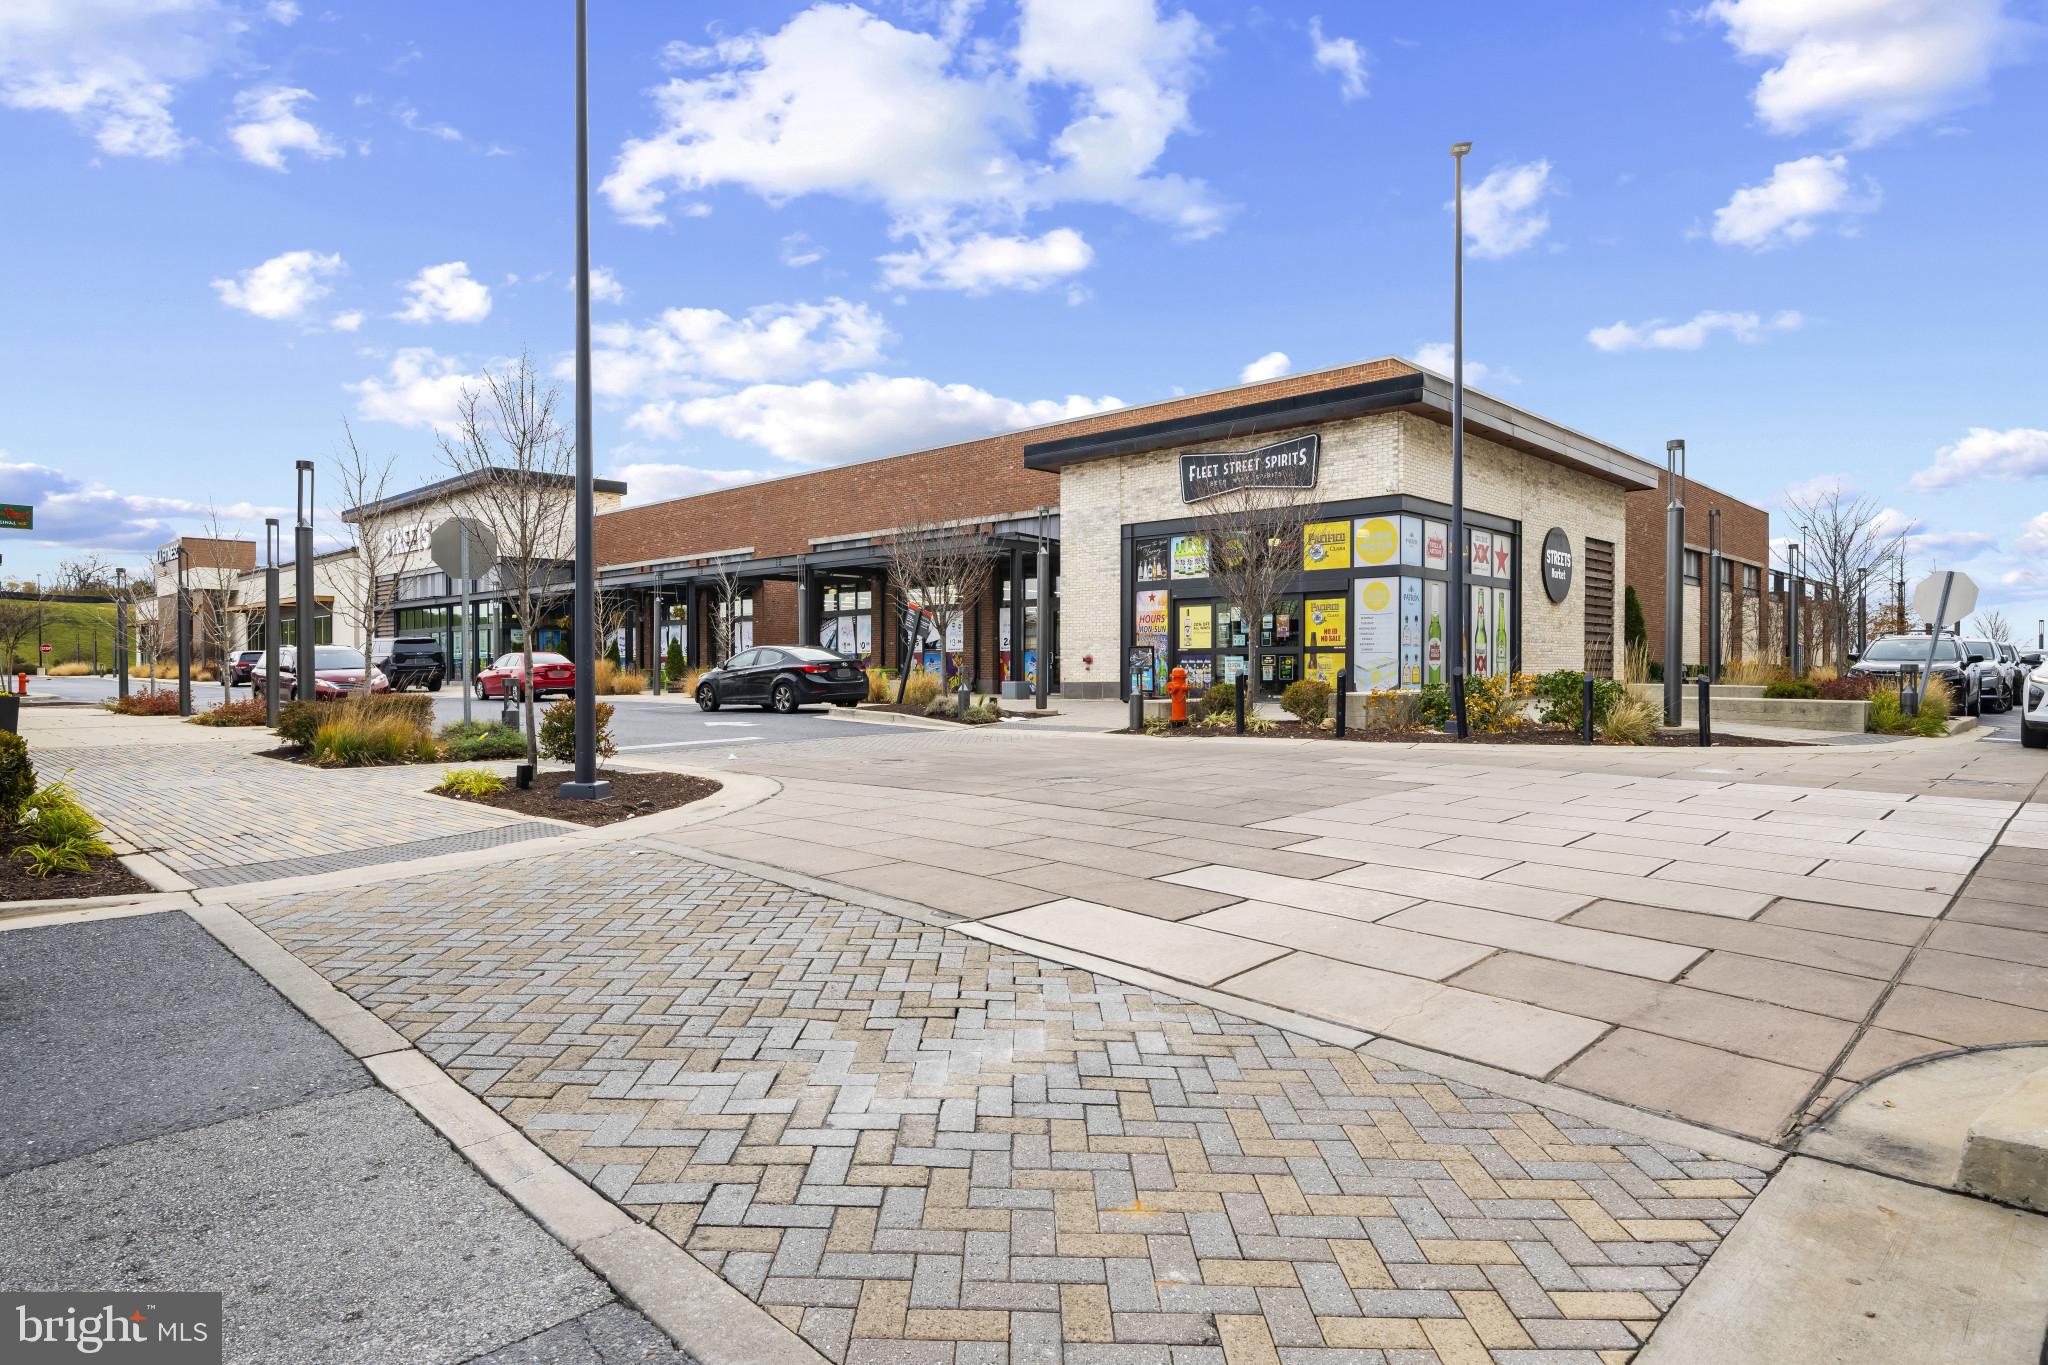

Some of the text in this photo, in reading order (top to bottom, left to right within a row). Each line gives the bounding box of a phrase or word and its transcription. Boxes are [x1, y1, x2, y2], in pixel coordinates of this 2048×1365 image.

[1189, 464, 1219, 481] FLEET
[1223, 457, 1260, 475] STREET
[1265, 448, 1307, 469] SPIRITS
[1546, 549, 1571, 568] STREETS
[1551, 567, 1567, 580] Market
[1140, 614, 1166, 624] HOURS
